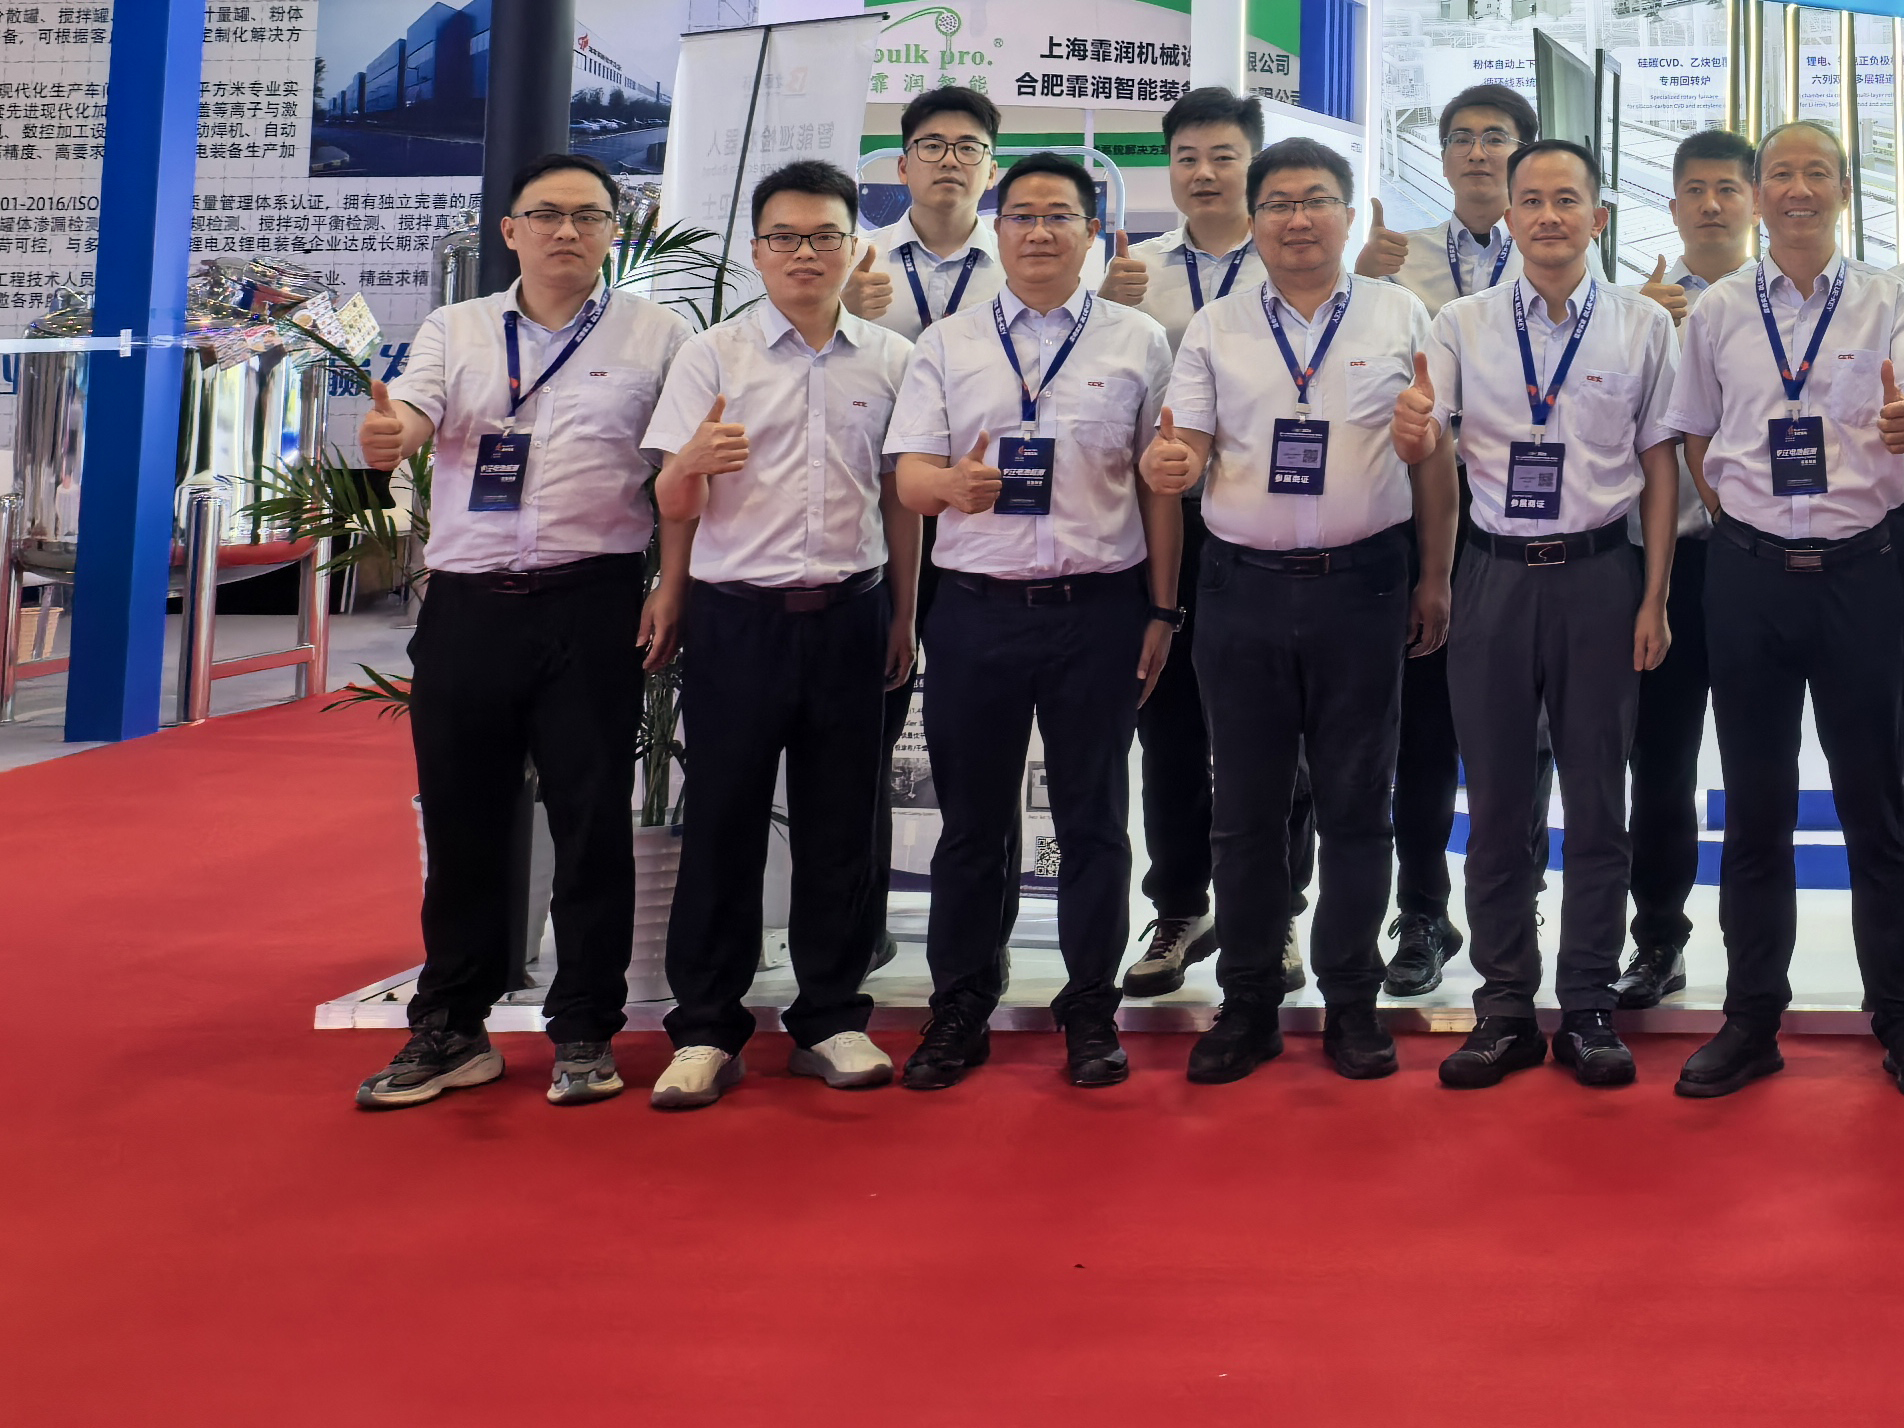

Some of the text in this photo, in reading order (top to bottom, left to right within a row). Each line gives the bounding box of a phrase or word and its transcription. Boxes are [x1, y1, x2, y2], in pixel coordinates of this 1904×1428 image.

[1659, 75, 1712, 87] 专用回转炉
